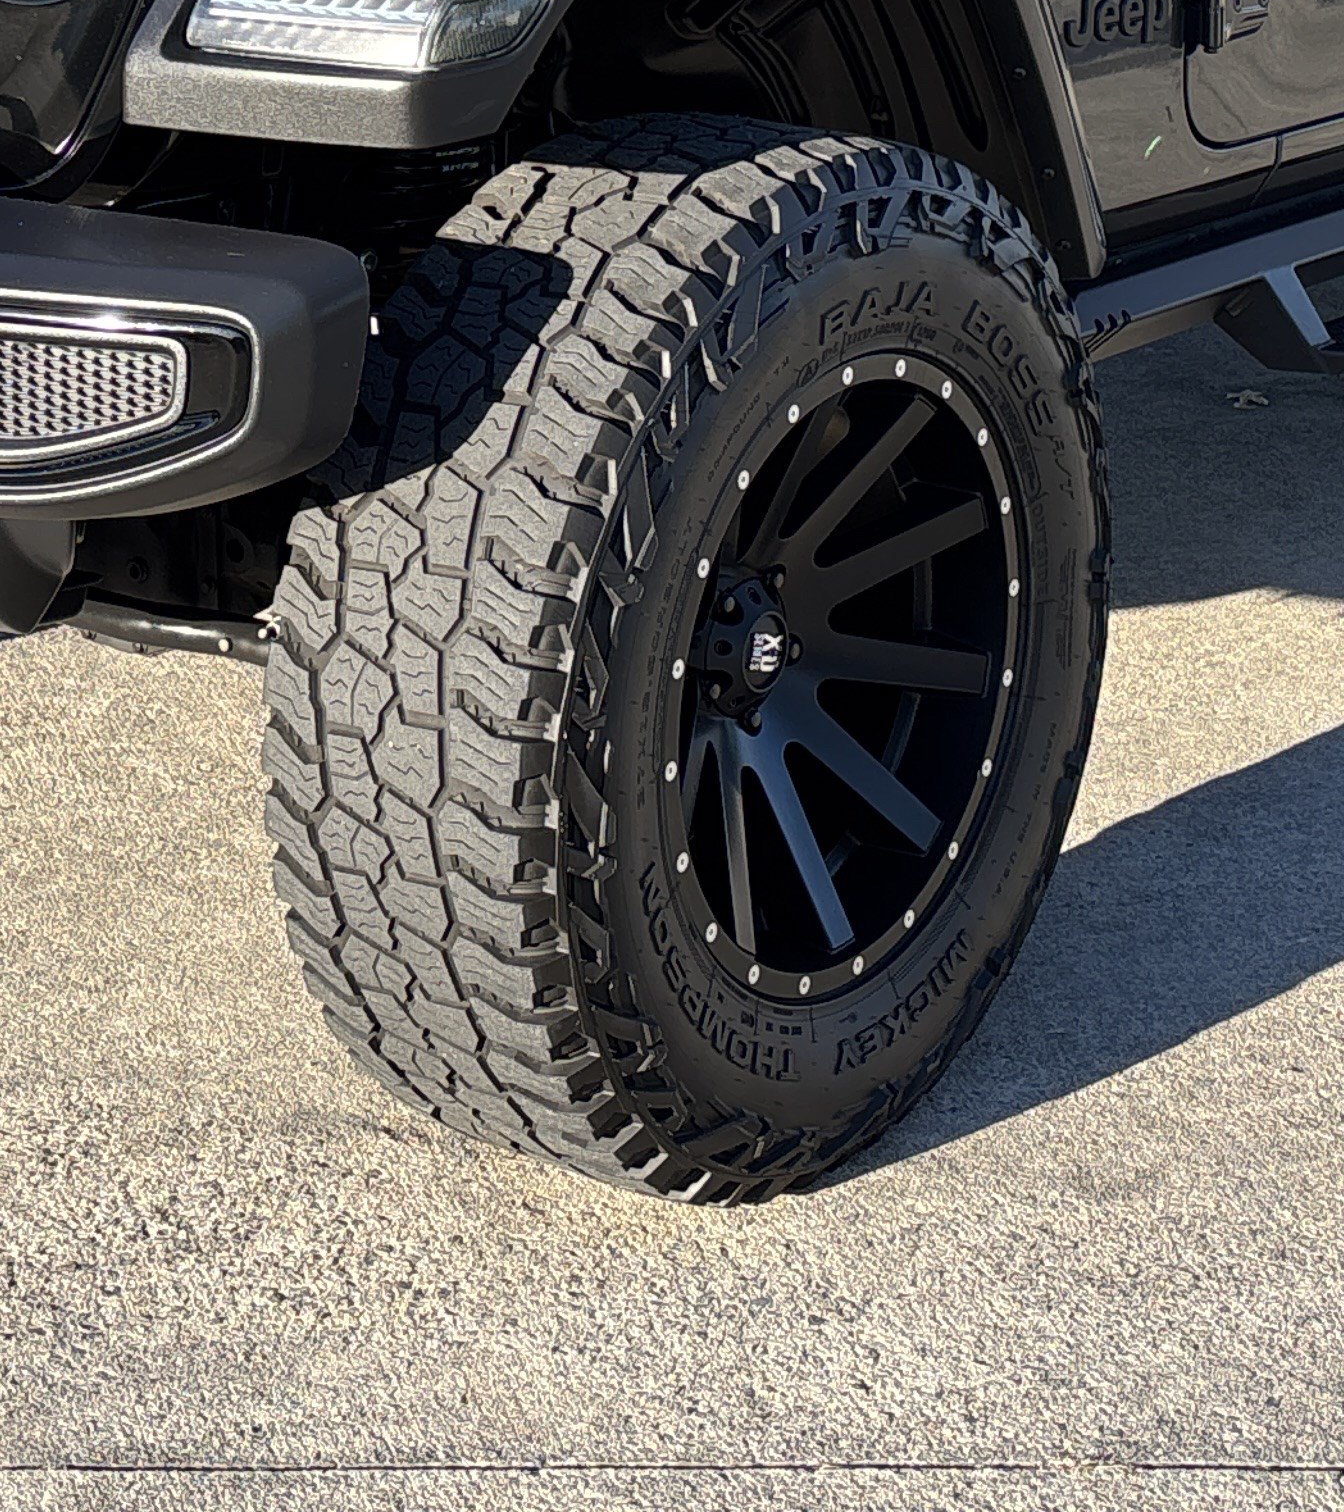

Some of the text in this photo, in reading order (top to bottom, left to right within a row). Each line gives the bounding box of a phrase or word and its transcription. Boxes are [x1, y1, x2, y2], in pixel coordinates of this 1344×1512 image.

[818, 279, 938, 347] BAJA
[960, 299, 1057, 438] BOSS
[1031, 505, 1049, 597] OUTSIDE
[638, 860, 973, 1083] MICKEY THOMPSON
